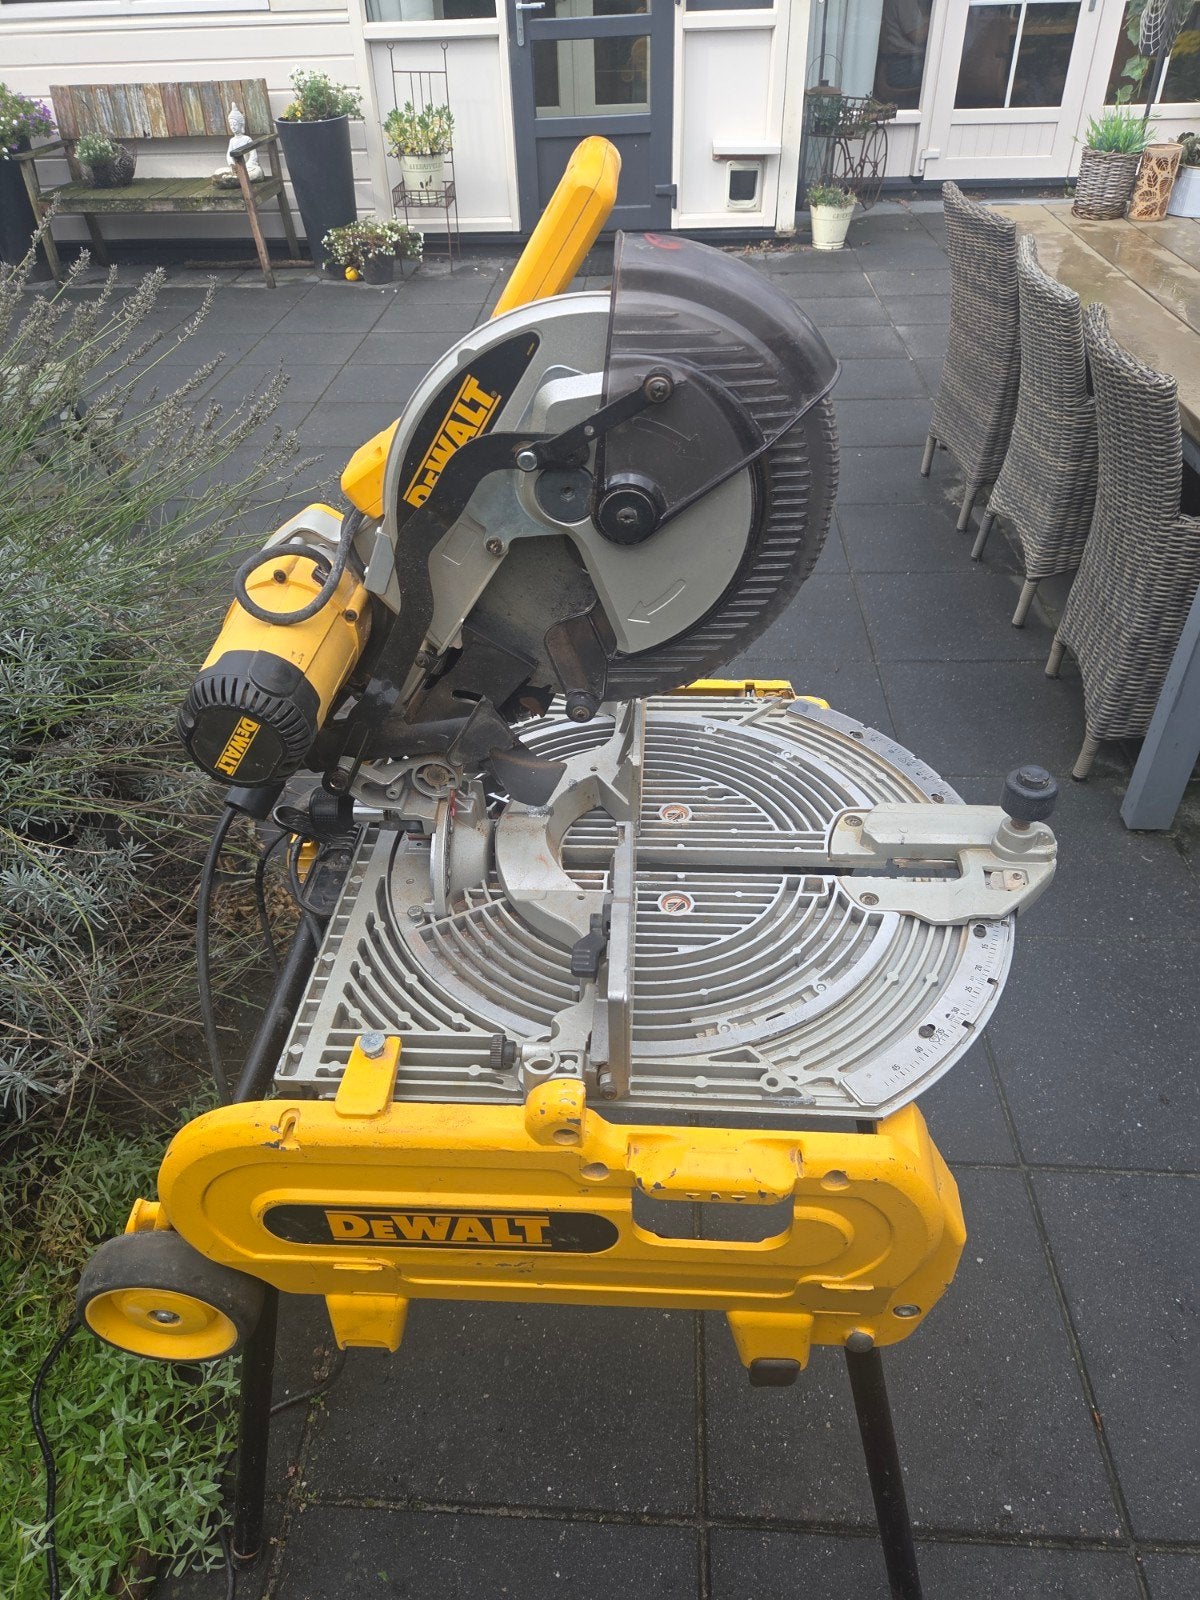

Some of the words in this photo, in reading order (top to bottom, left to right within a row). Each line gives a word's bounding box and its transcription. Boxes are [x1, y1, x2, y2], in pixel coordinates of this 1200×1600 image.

[407, 376, 496, 508] DEWALT
[216, 717, 258, 775] DEWALT
[891, 1063, 901, 1072] 45
[326, 1213, 550, 1243] DEWALT
